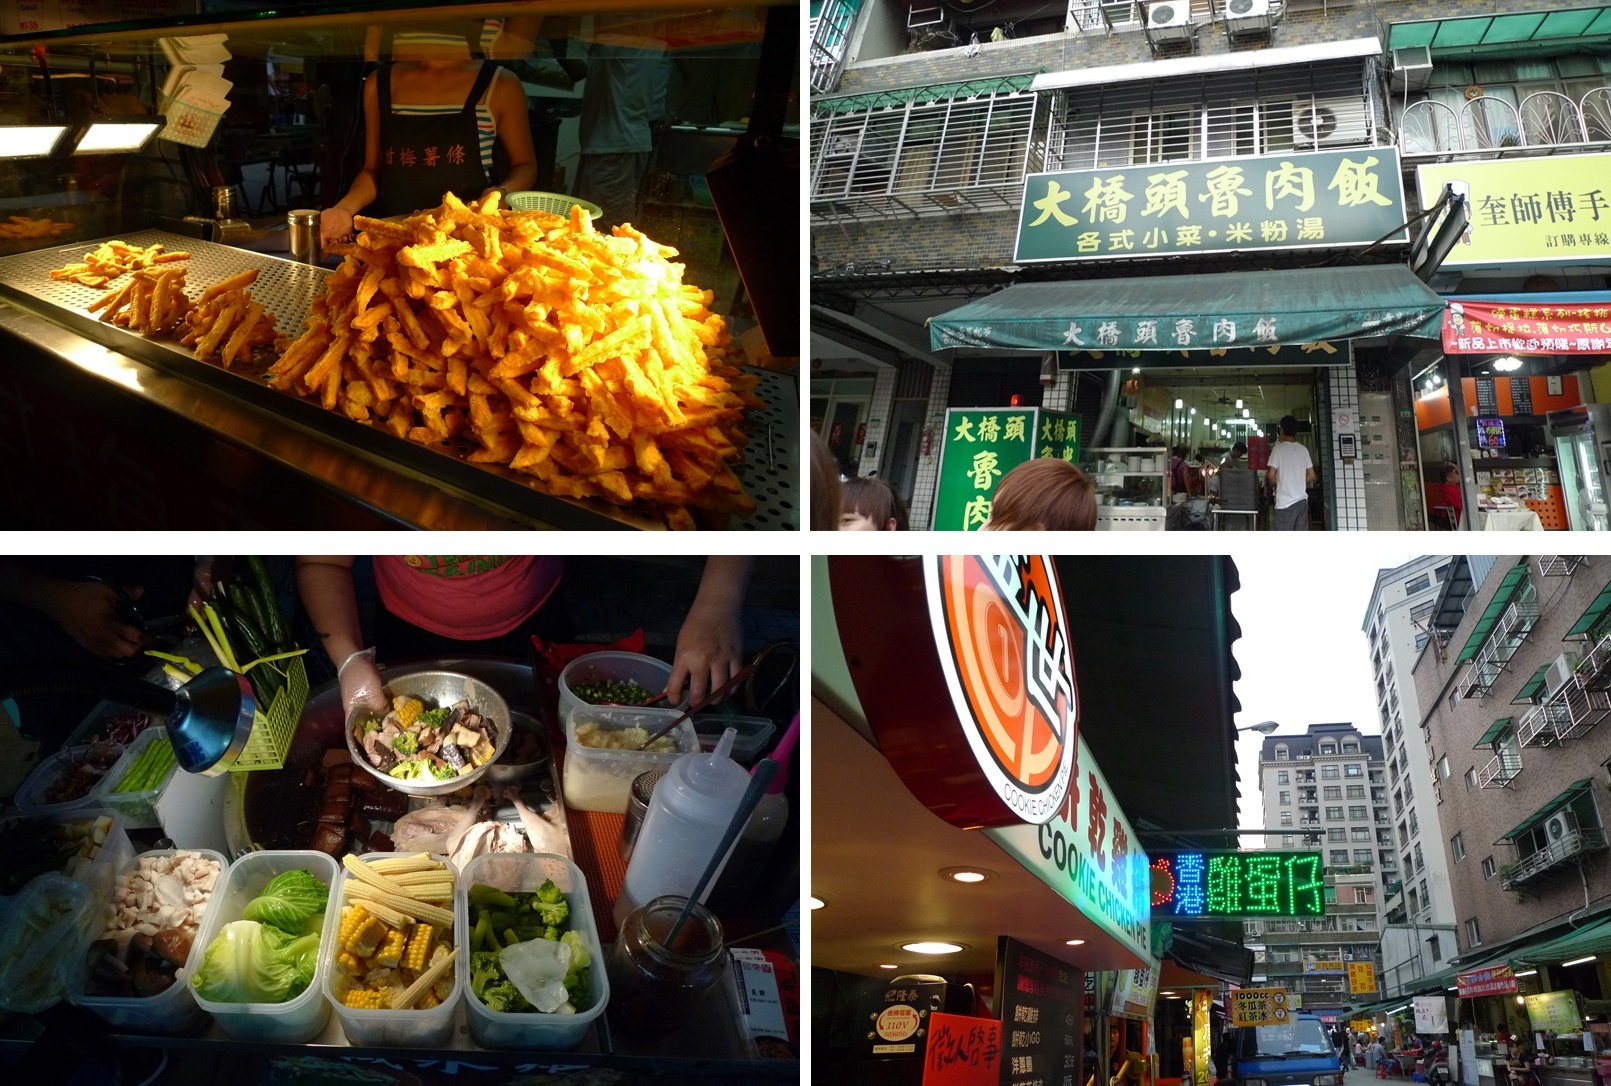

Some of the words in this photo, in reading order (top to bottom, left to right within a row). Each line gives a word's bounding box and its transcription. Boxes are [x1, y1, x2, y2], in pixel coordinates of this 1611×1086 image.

[1028, 156, 1393, 228] 大橋頭魯肉飯
[1476, 188, 1611, 227] 奎師傅手
[1546, 232, 1610, 248] 訂購專線
[1062, 317, 1278, 347] 大橋頭魯肉飯
[953, 415, 1027, 443] 大橋頭
[1041, 417, 1077, 443] 大橋頭
[963, 450, 1002, 531] 魯肉
[1004, 783, 1037, 815] COOKIE
[1038, 783, 1064, 816] CHICKEN
[1060, 763, 1069, 785] PIE
[1038, 823, 1096, 904] COOKIE
[1098, 880, 1136, 938] CHICKEN
[1136, 921, 1147, 951] PIE
[1175, 853, 1205, 914] 香港
[1207, 855, 1324, 914] 雞蛋仔
[1357, 965, 1367, 990] 豆花
[1235, 992, 1270, 1001] 1000cc
[1238, 1001, 1267, 1011] 冬瓜茶
[886, 1021, 909, 1030] 110V
[1238, 1011, 1268, 1022] 紅茶冰
